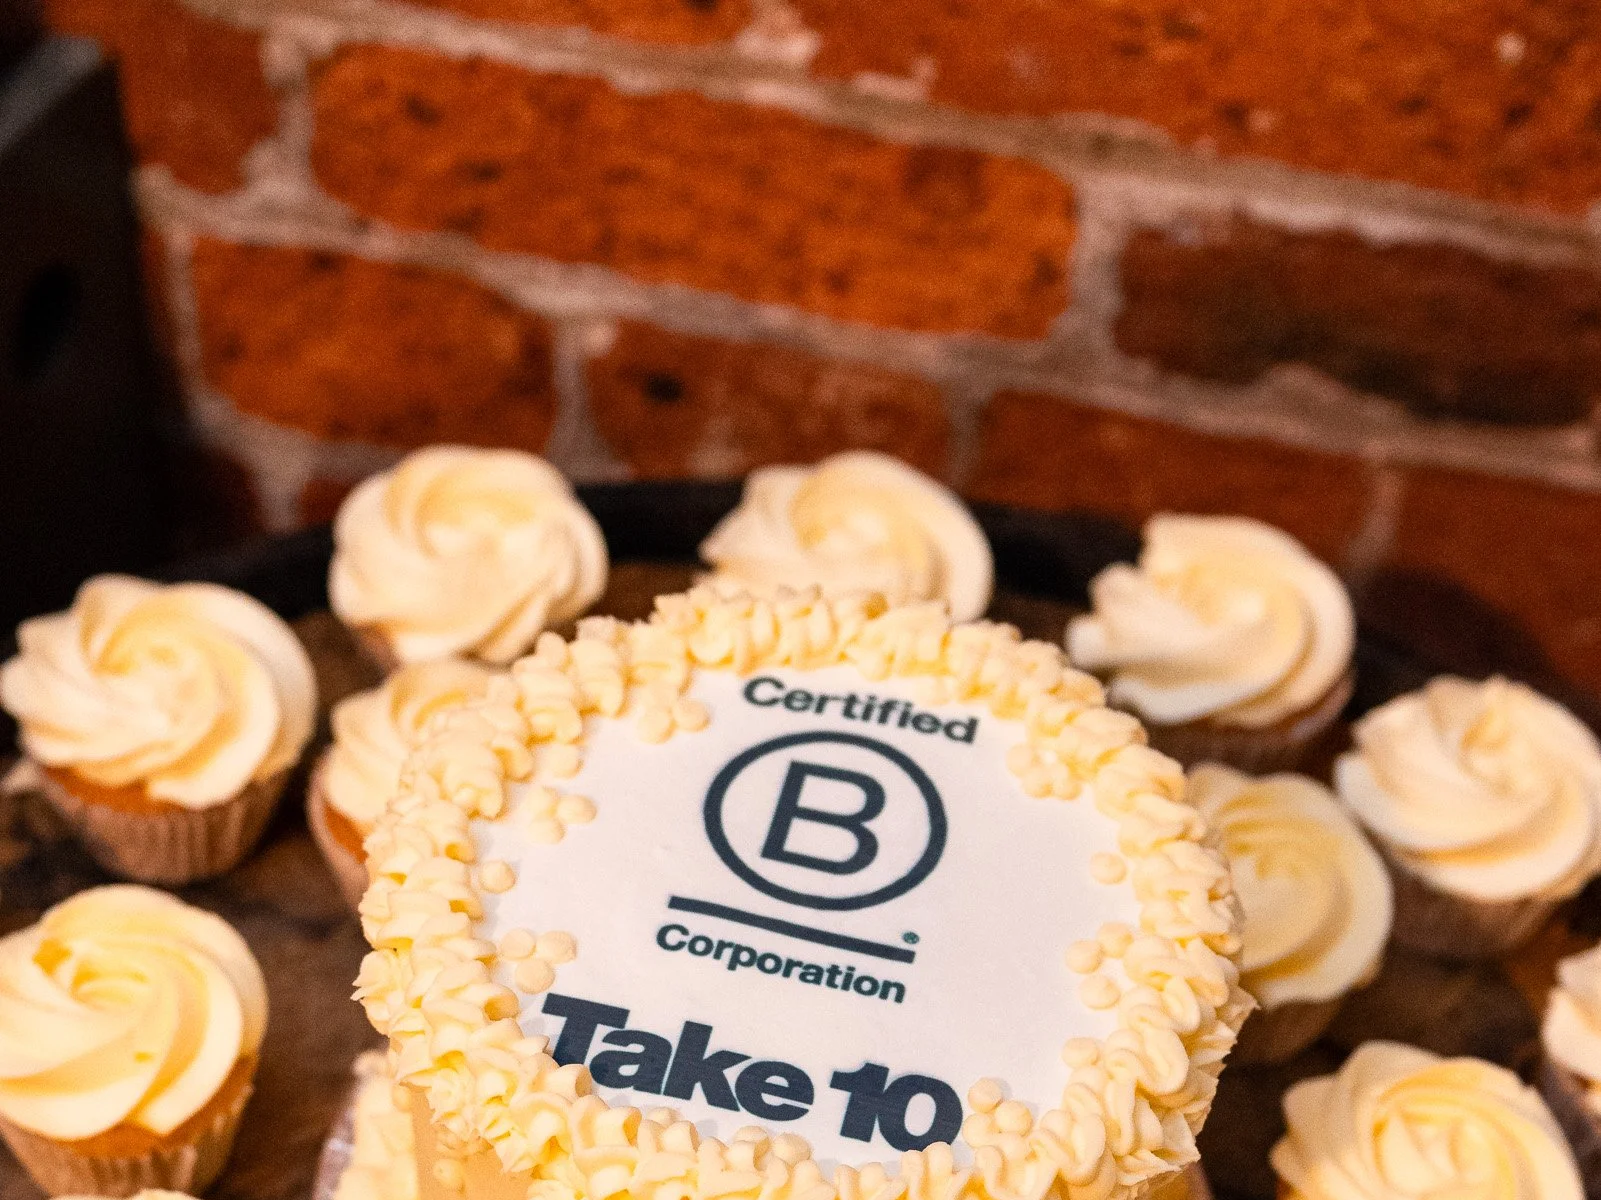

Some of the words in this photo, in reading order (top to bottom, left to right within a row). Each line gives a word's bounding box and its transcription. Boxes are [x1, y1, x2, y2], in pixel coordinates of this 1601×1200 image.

[743, 676, 979, 745] Certified
[761, 760, 886, 876] B
[656, 922, 906, 1005] Corporation
[541, 992, 815, 1122] Take
[829, 1062, 964, 1153] 10
